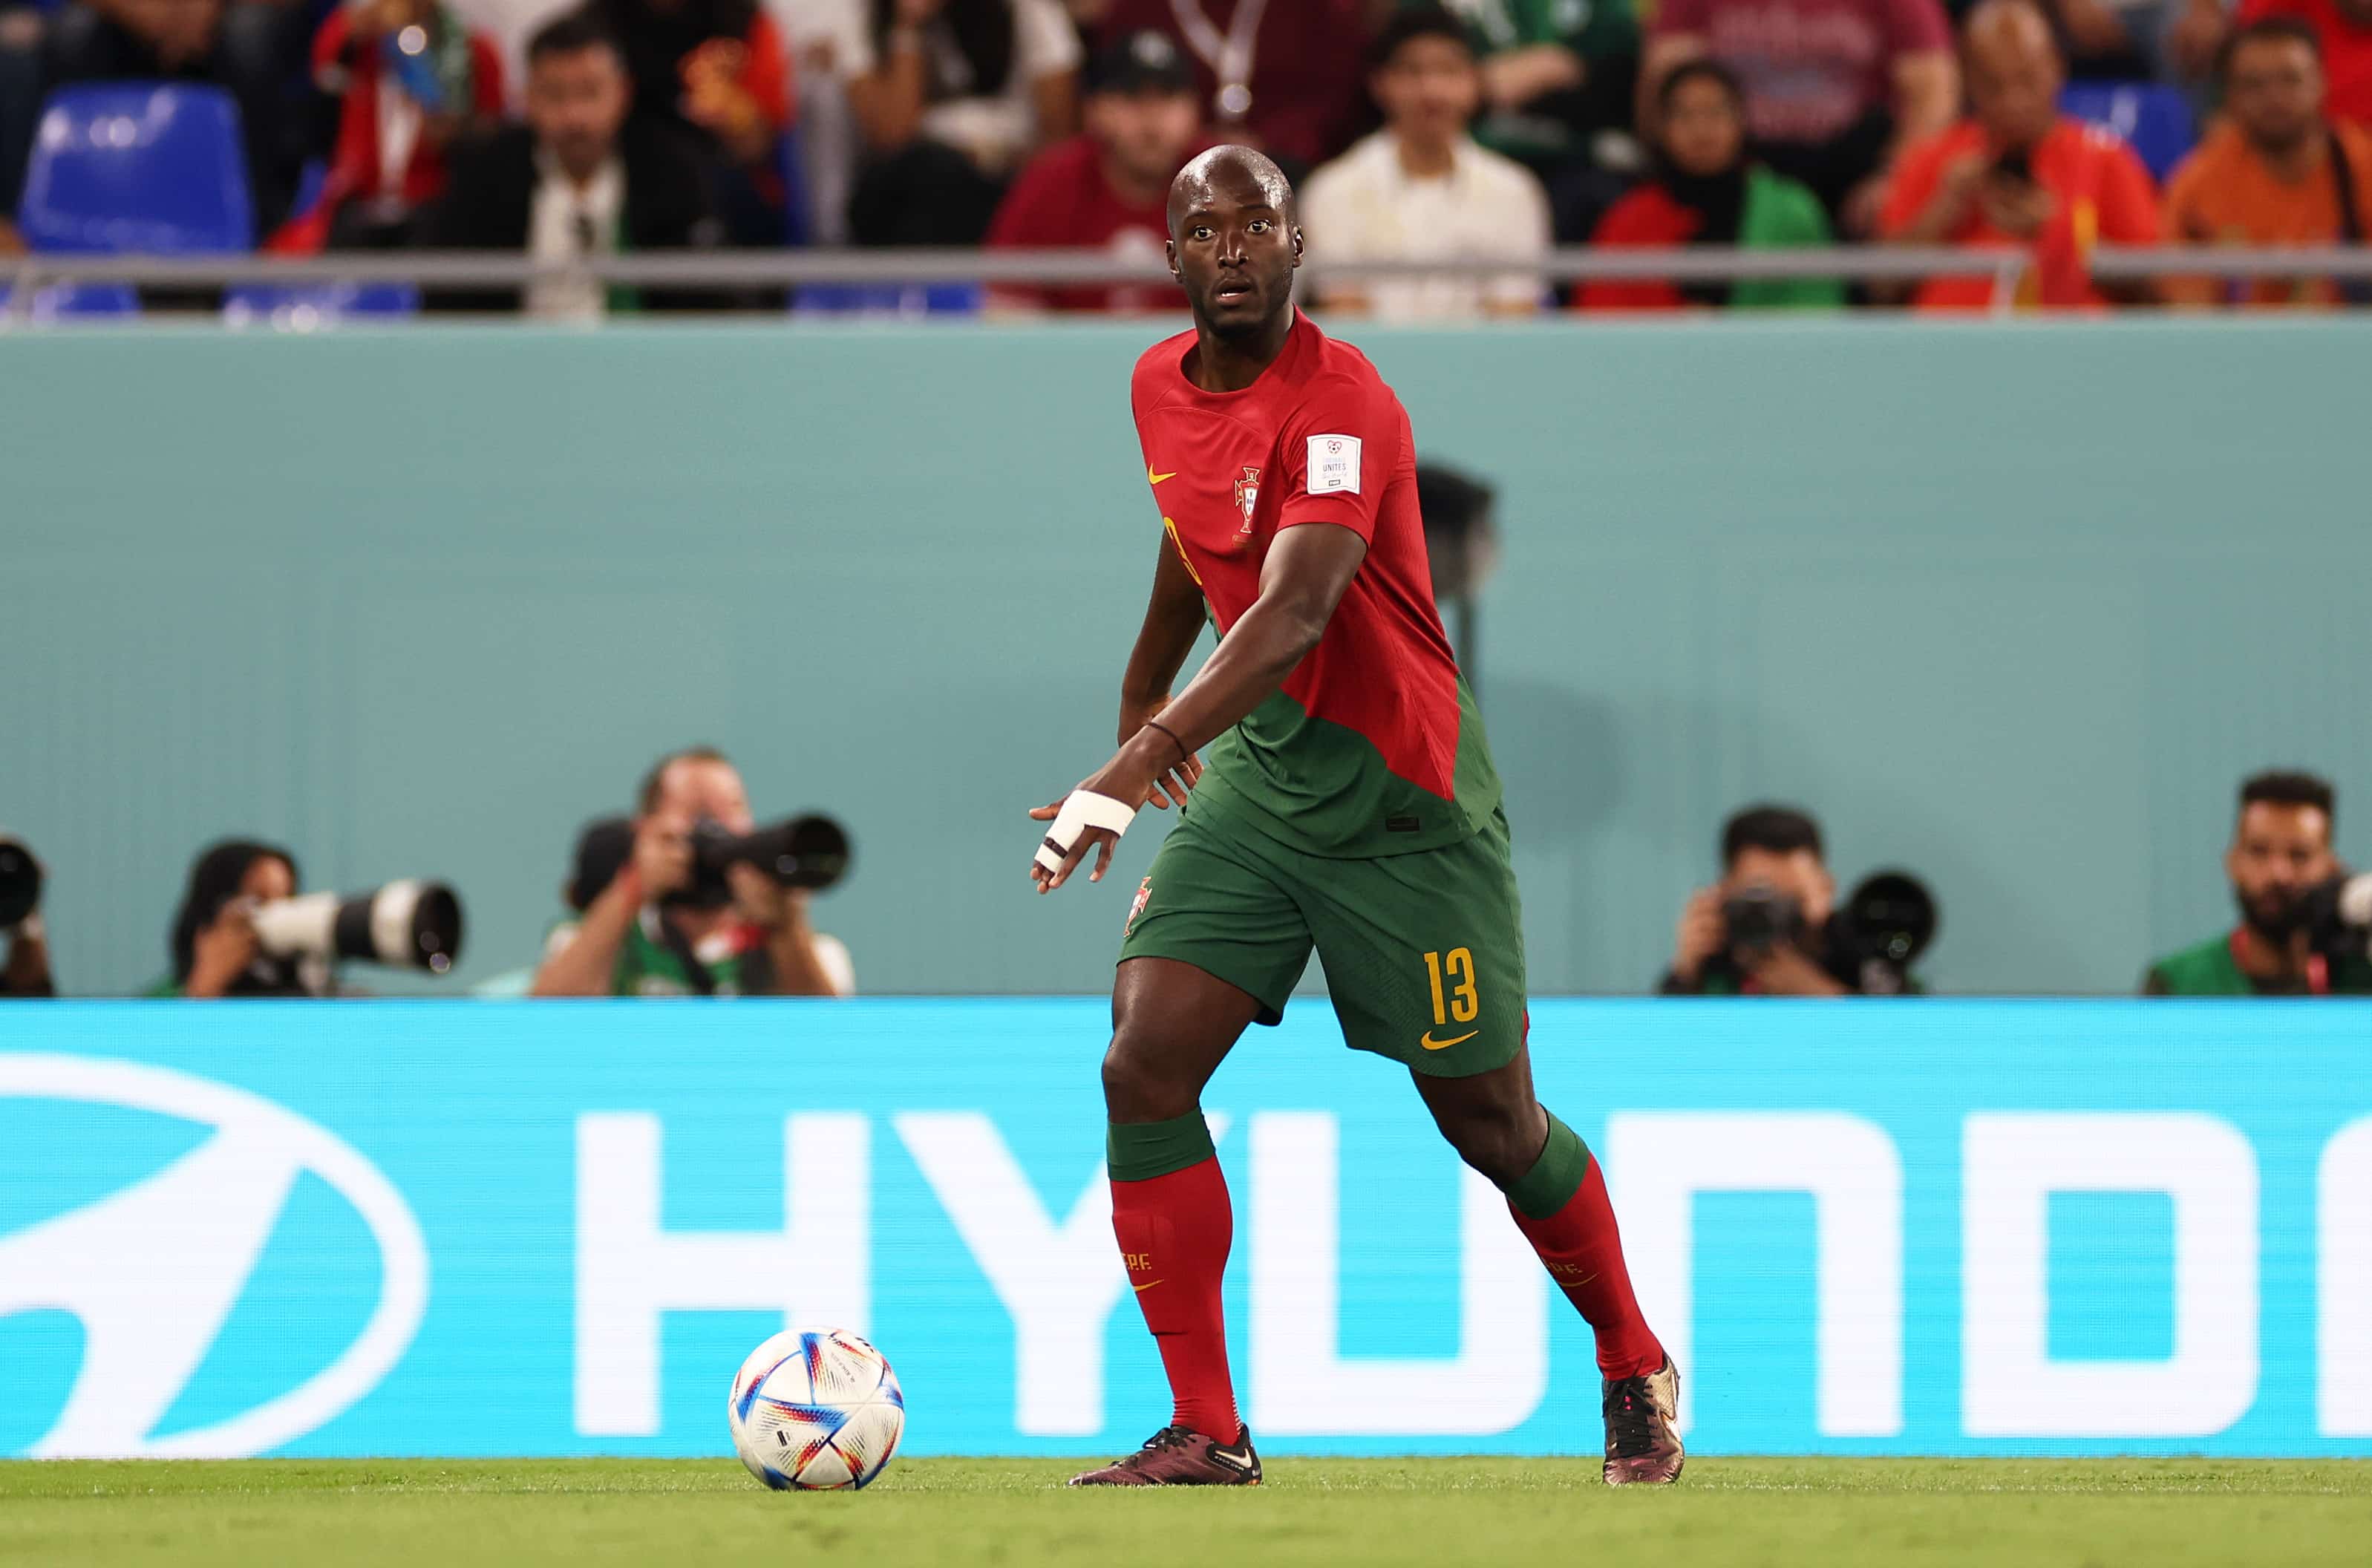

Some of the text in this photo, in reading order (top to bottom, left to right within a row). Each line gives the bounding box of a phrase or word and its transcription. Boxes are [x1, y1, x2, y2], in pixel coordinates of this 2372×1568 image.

[1323, 463, 1347, 472] UNITES
[1423, 947, 1478, 1025] 13
[574, 1111, 2372, 1437] HYUND
